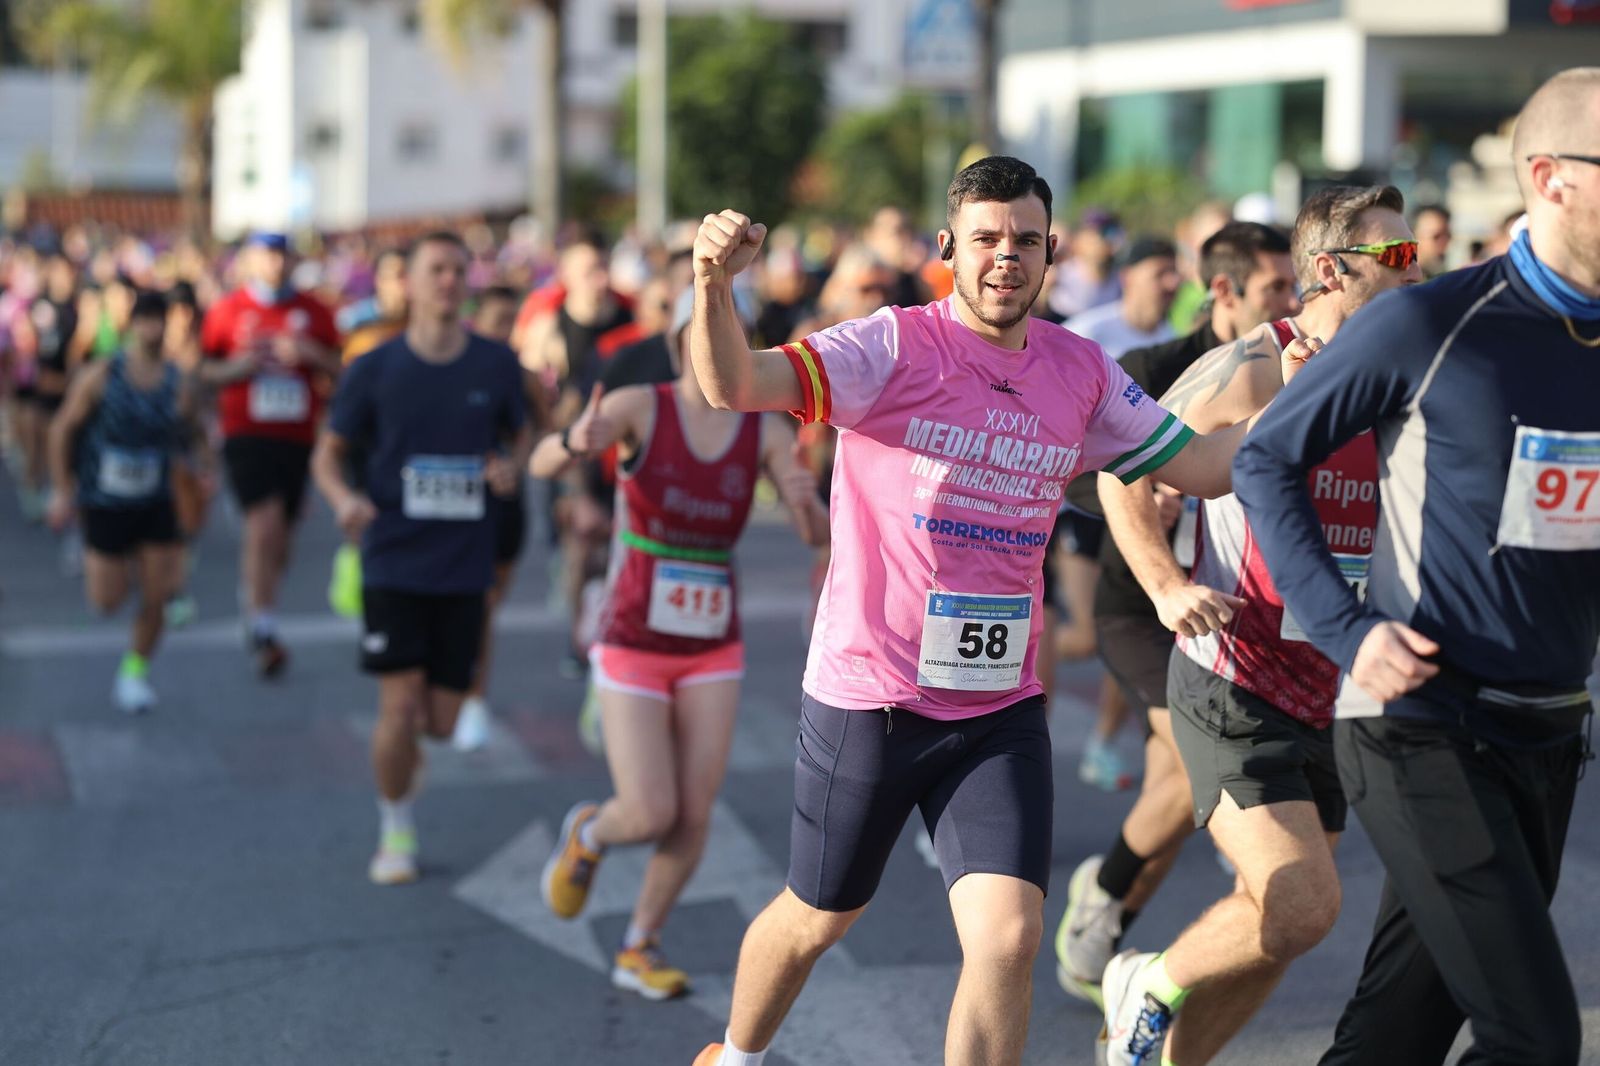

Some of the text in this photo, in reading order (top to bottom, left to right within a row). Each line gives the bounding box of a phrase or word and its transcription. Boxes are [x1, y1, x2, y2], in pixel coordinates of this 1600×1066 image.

[984, 408, 1040, 437] XXXVI
[903, 416, 1081, 479] MEDIA MARATÓ
[910, 454, 1035, 500] INTERNACIONAL
[1314, 469, 1376, 509] Ripo
[1535, 466, 1600, 513] 97
[933, 492, 998, 514] INTERNATIONAL
[997, 503, 1022, 517] HALF
[912, 513, 1047, 547] TORREMOLINOS
[931, 538, 953, 547] Costa
[956, 540, 968, 549] del
[970, 542, 983, 550] Sol
[985, 544, 1011, 555] ESPAÑA
[1322, 523, 1375, 550] nne
[957, 622, 1009, 660] 58
[925, 659, 959, 668] ALTAZUBIAGA
